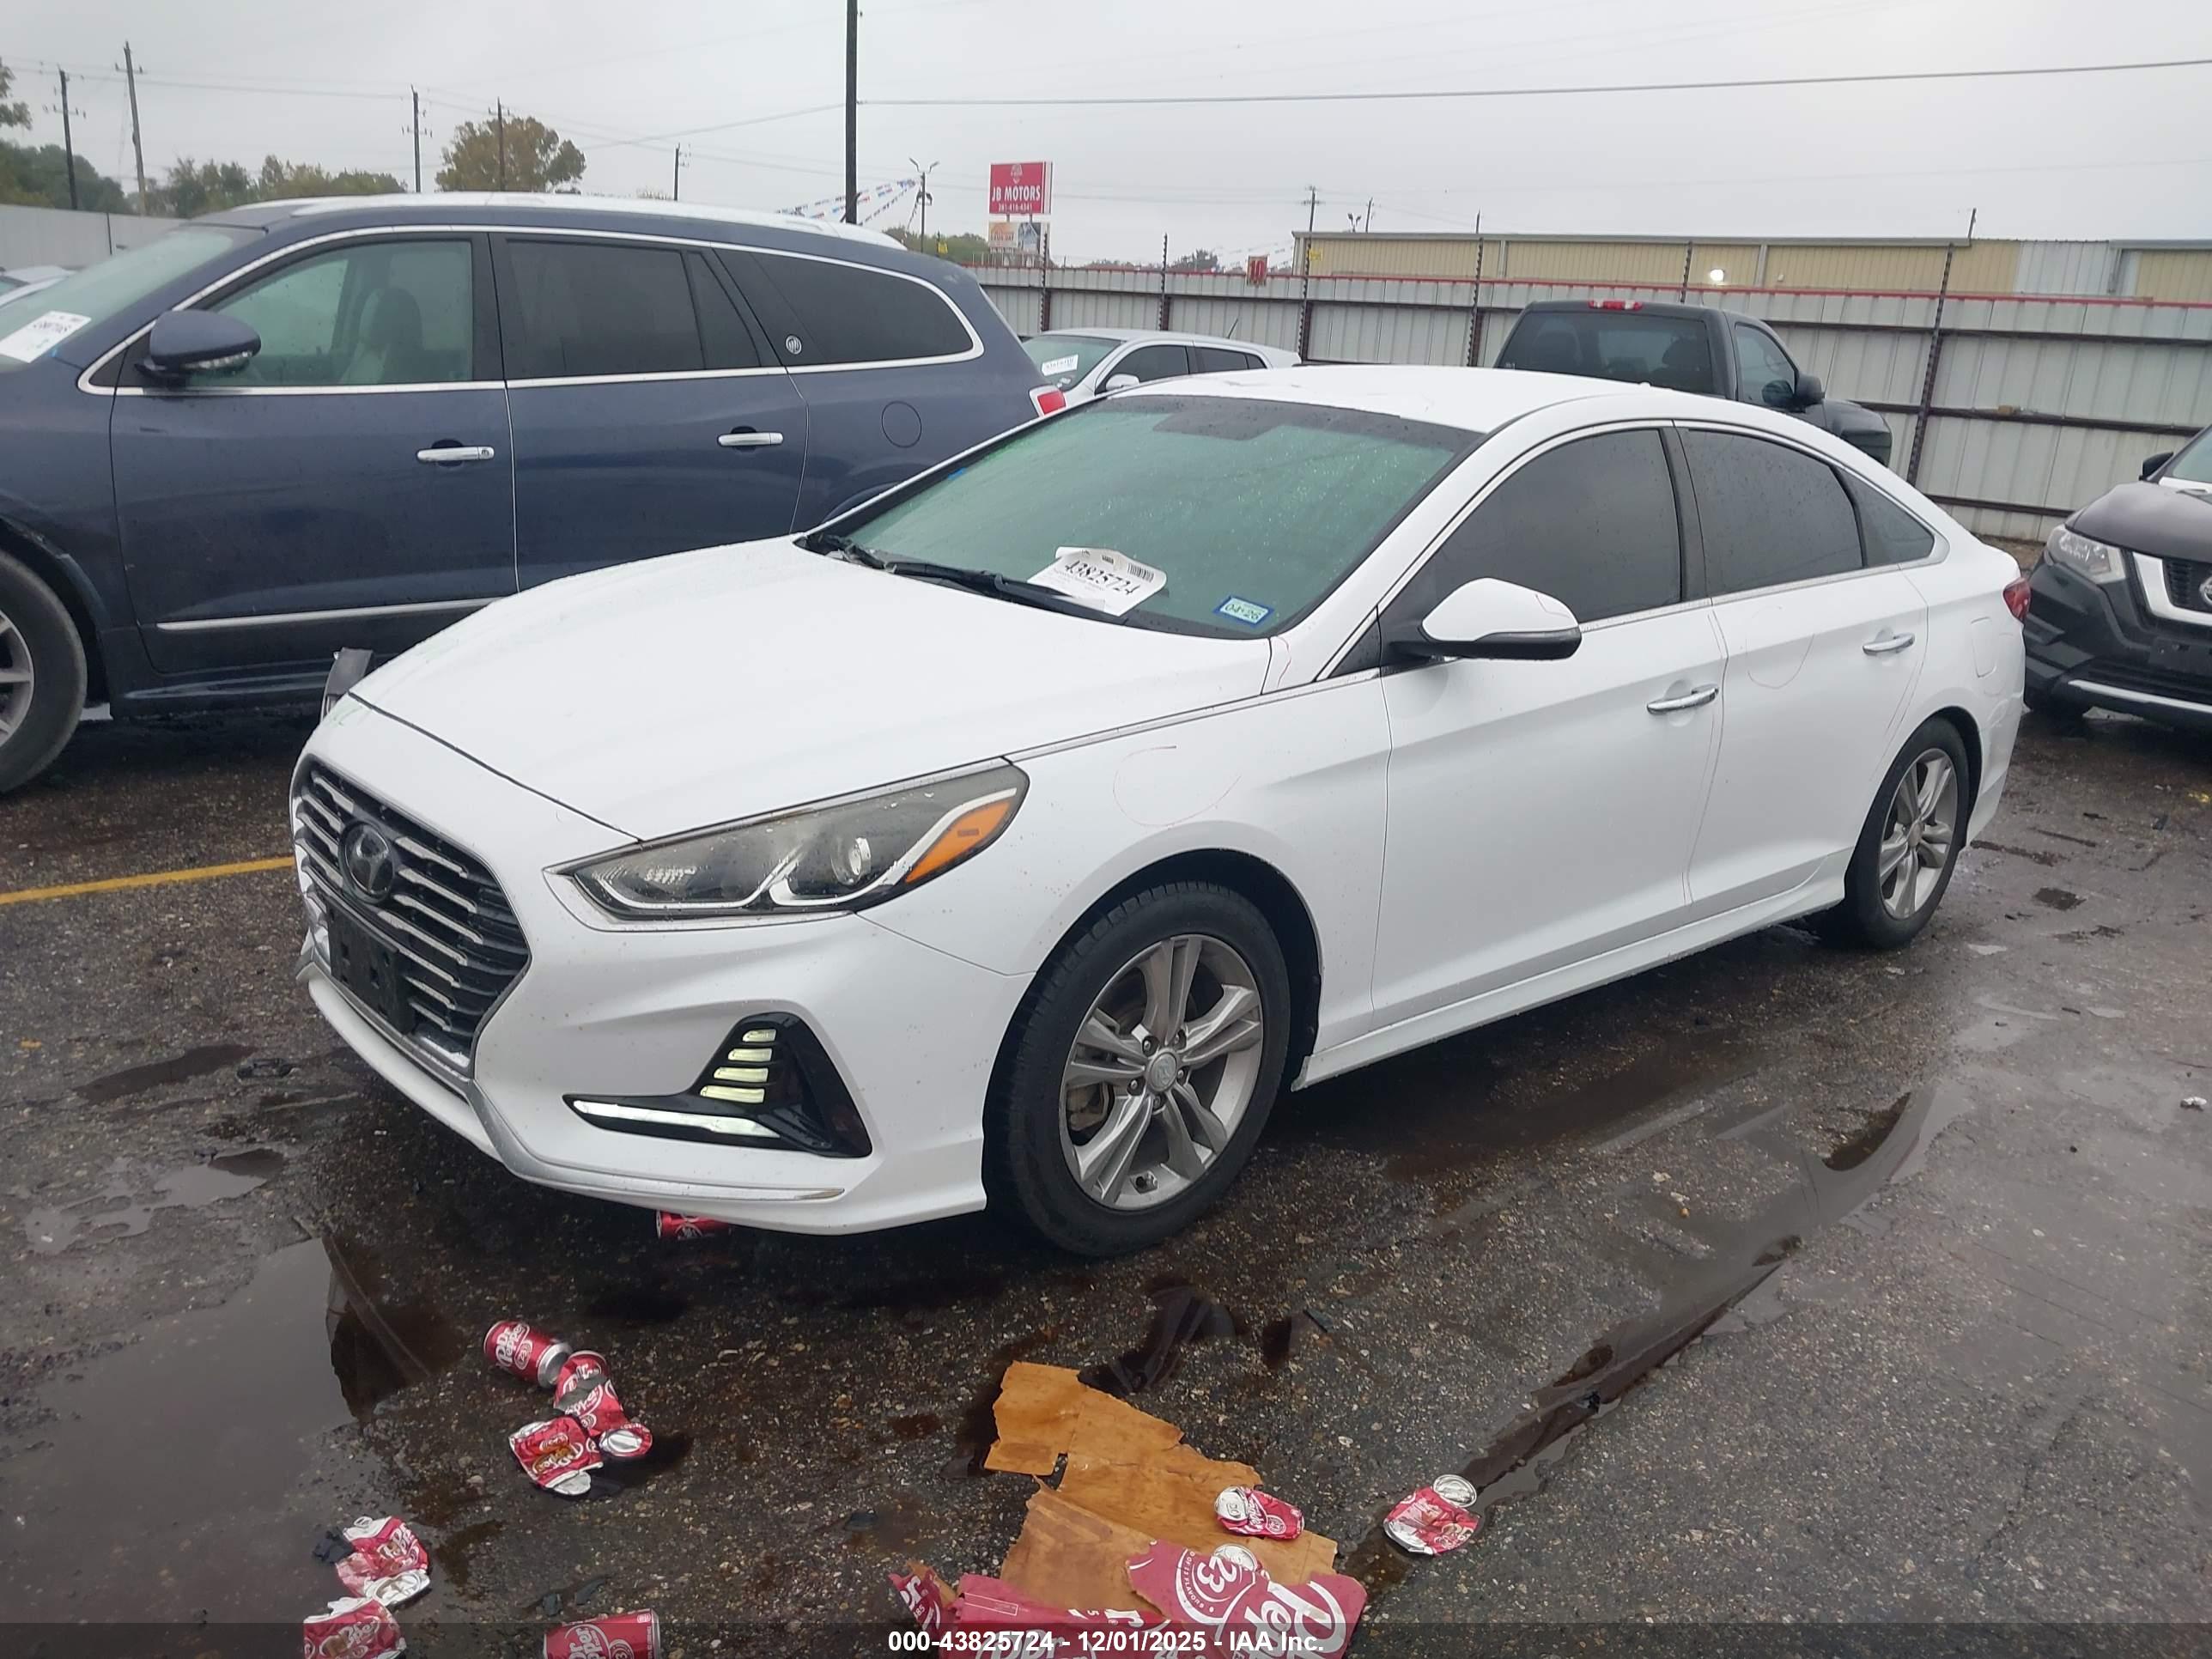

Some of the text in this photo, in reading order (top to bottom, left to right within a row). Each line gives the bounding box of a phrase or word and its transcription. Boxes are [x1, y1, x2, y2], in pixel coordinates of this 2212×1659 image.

[992, 185, 1041, 202] JB MOTORS
[1065, 560, 1140, 595] 43825724
[1184, 1577, 1205, 1607] FLAVORS
